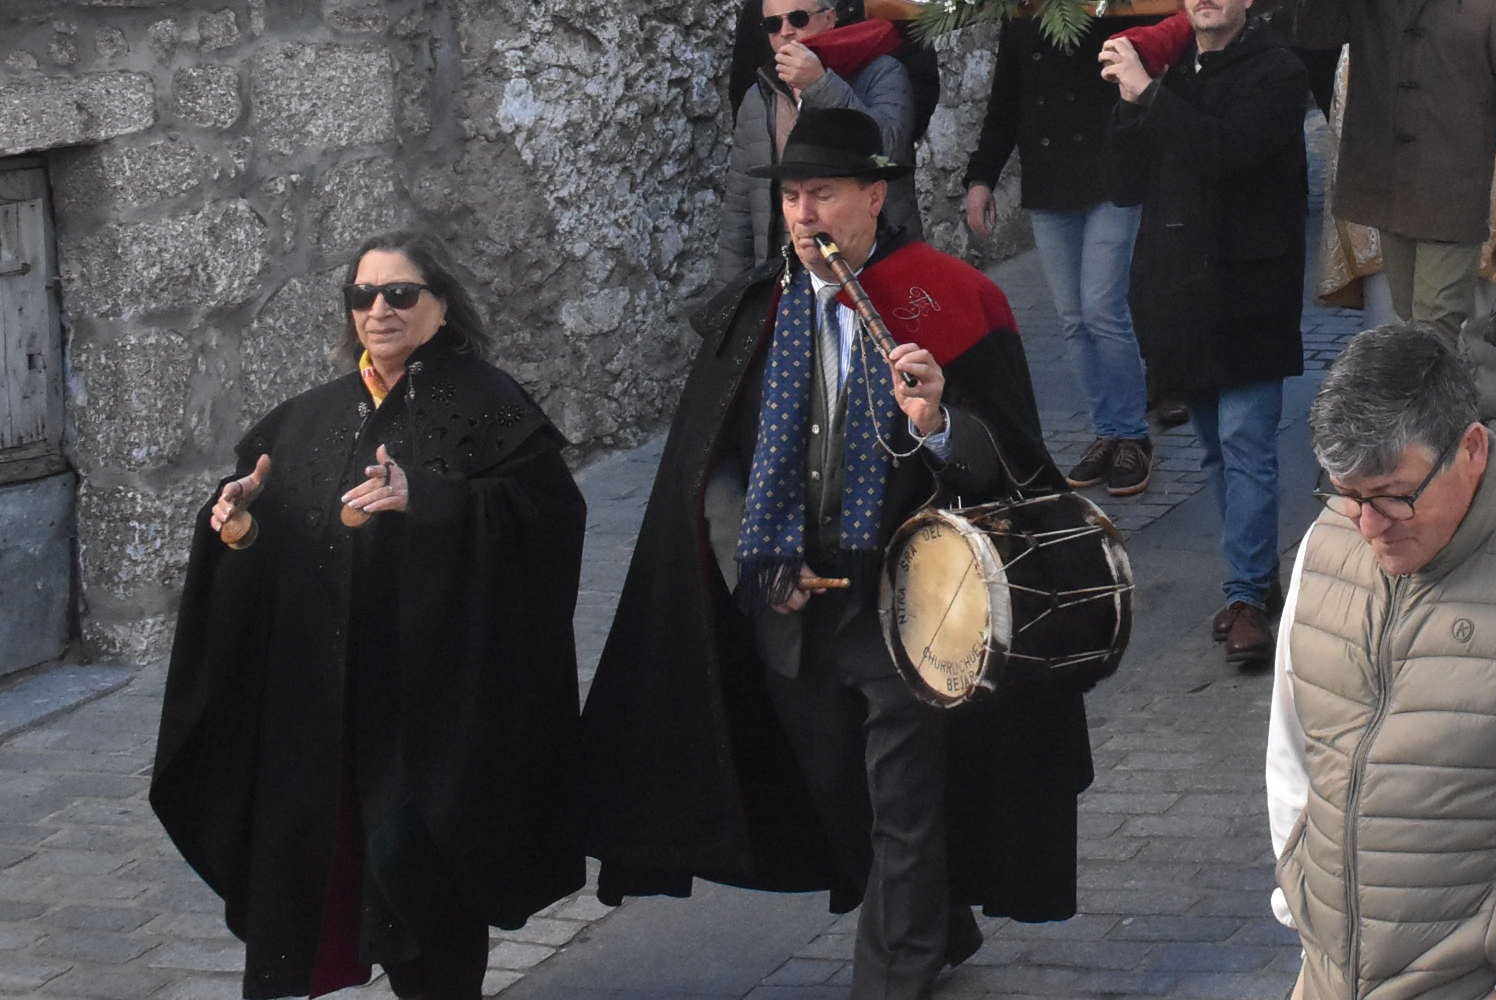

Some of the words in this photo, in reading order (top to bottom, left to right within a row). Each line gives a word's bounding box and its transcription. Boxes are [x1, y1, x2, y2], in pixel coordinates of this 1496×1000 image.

[902, 544, 917, 572] SRA
[922, 527, 942, 541] DEL
[946, 670, 976, 692] BEJAR
